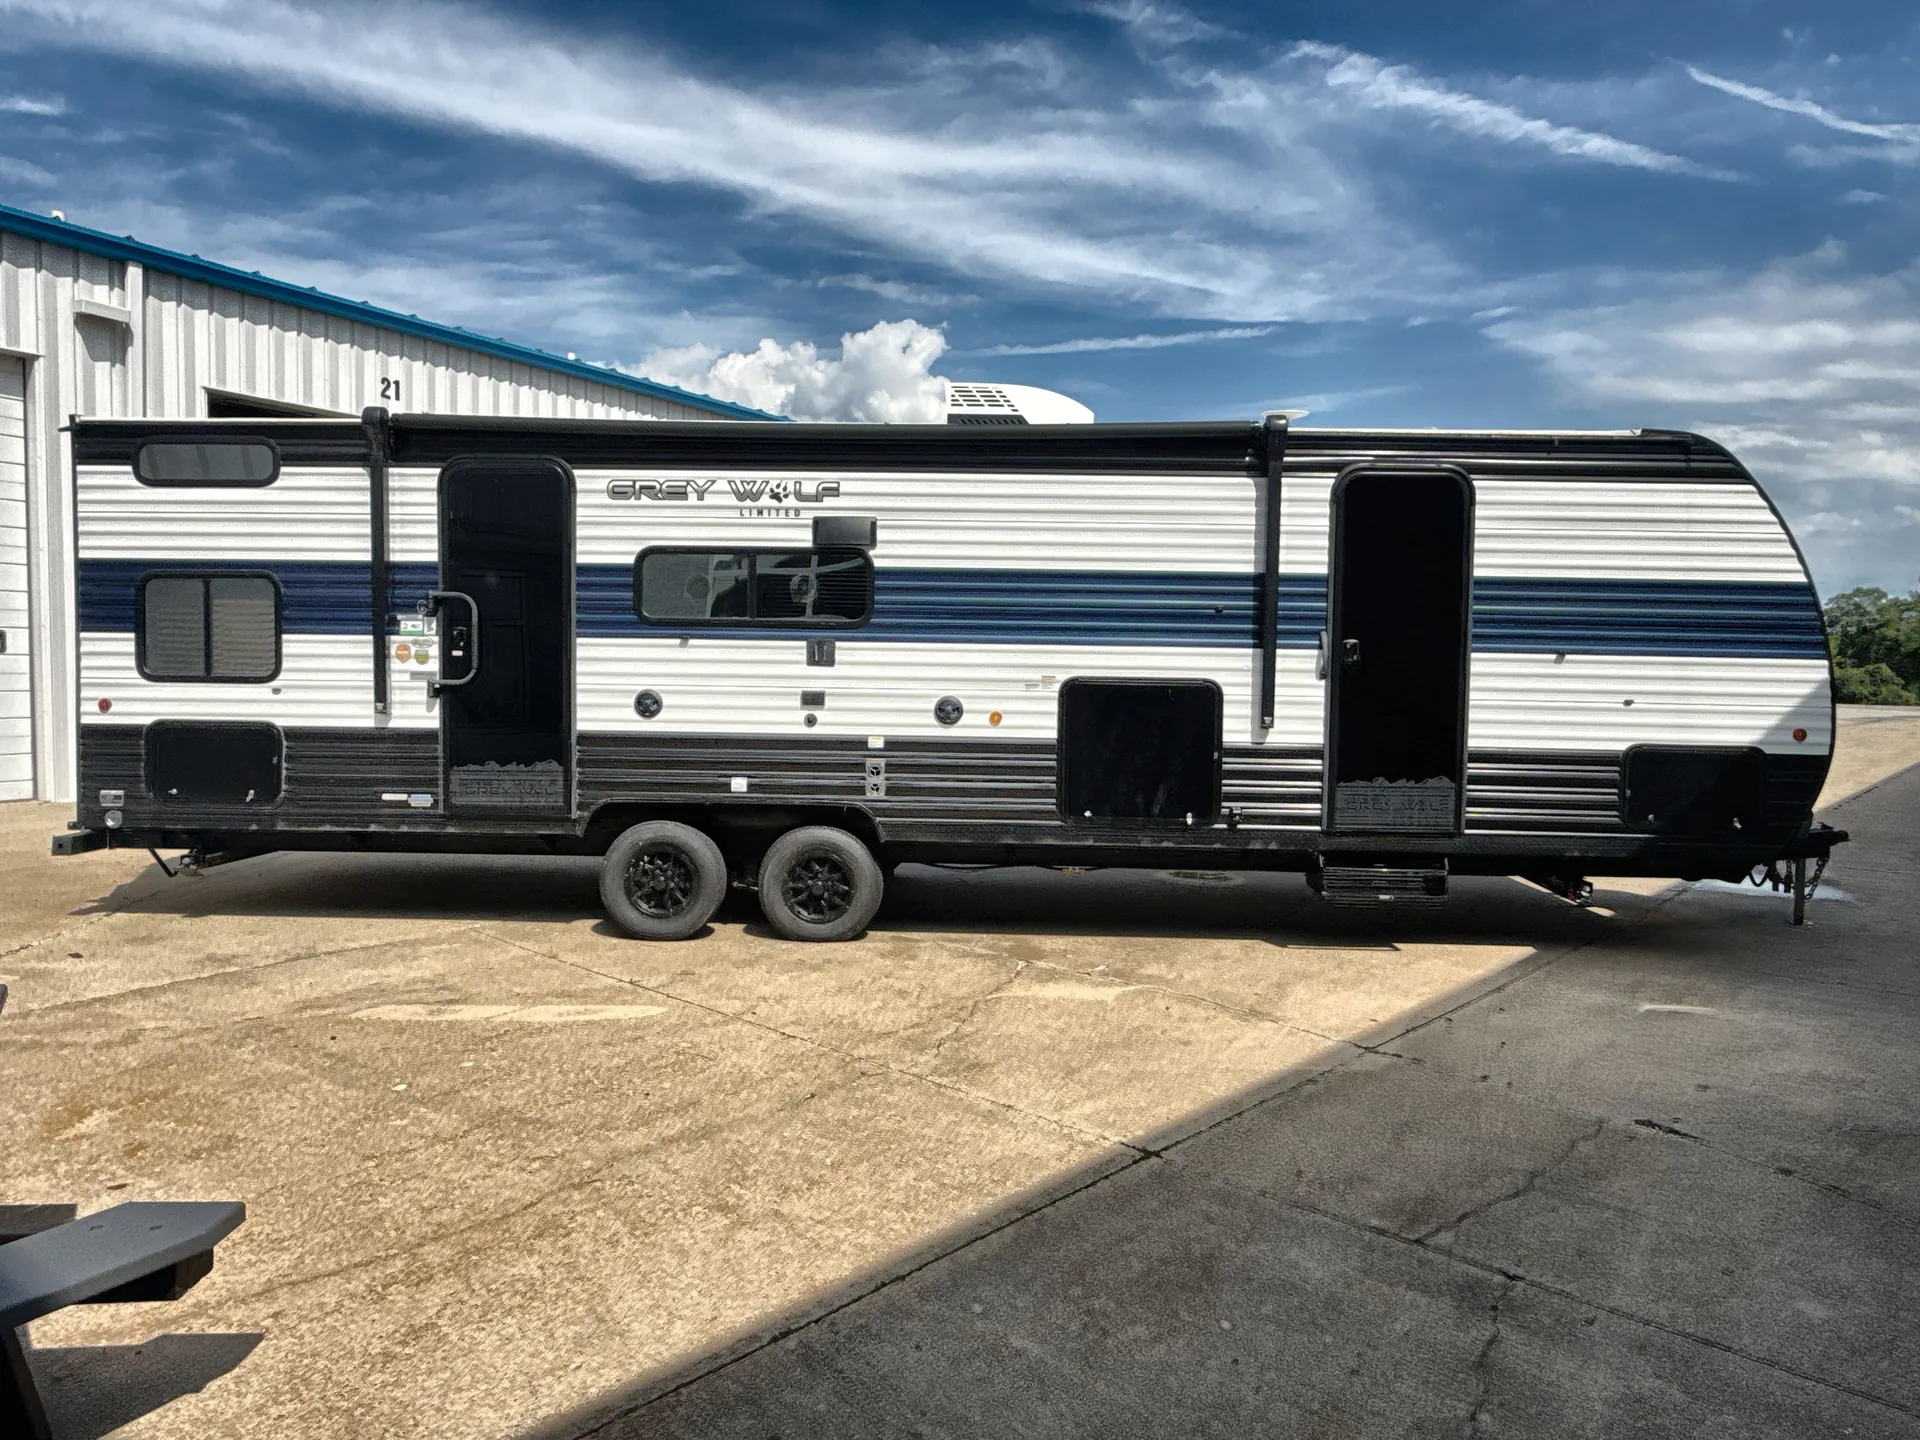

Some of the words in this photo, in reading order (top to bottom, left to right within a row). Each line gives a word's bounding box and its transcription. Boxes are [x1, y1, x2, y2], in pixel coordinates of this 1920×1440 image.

[380, 376, 401, 401] 21
[606, 479, 717, 501] GREY
[739, 508, 801, 517] LIMITED
